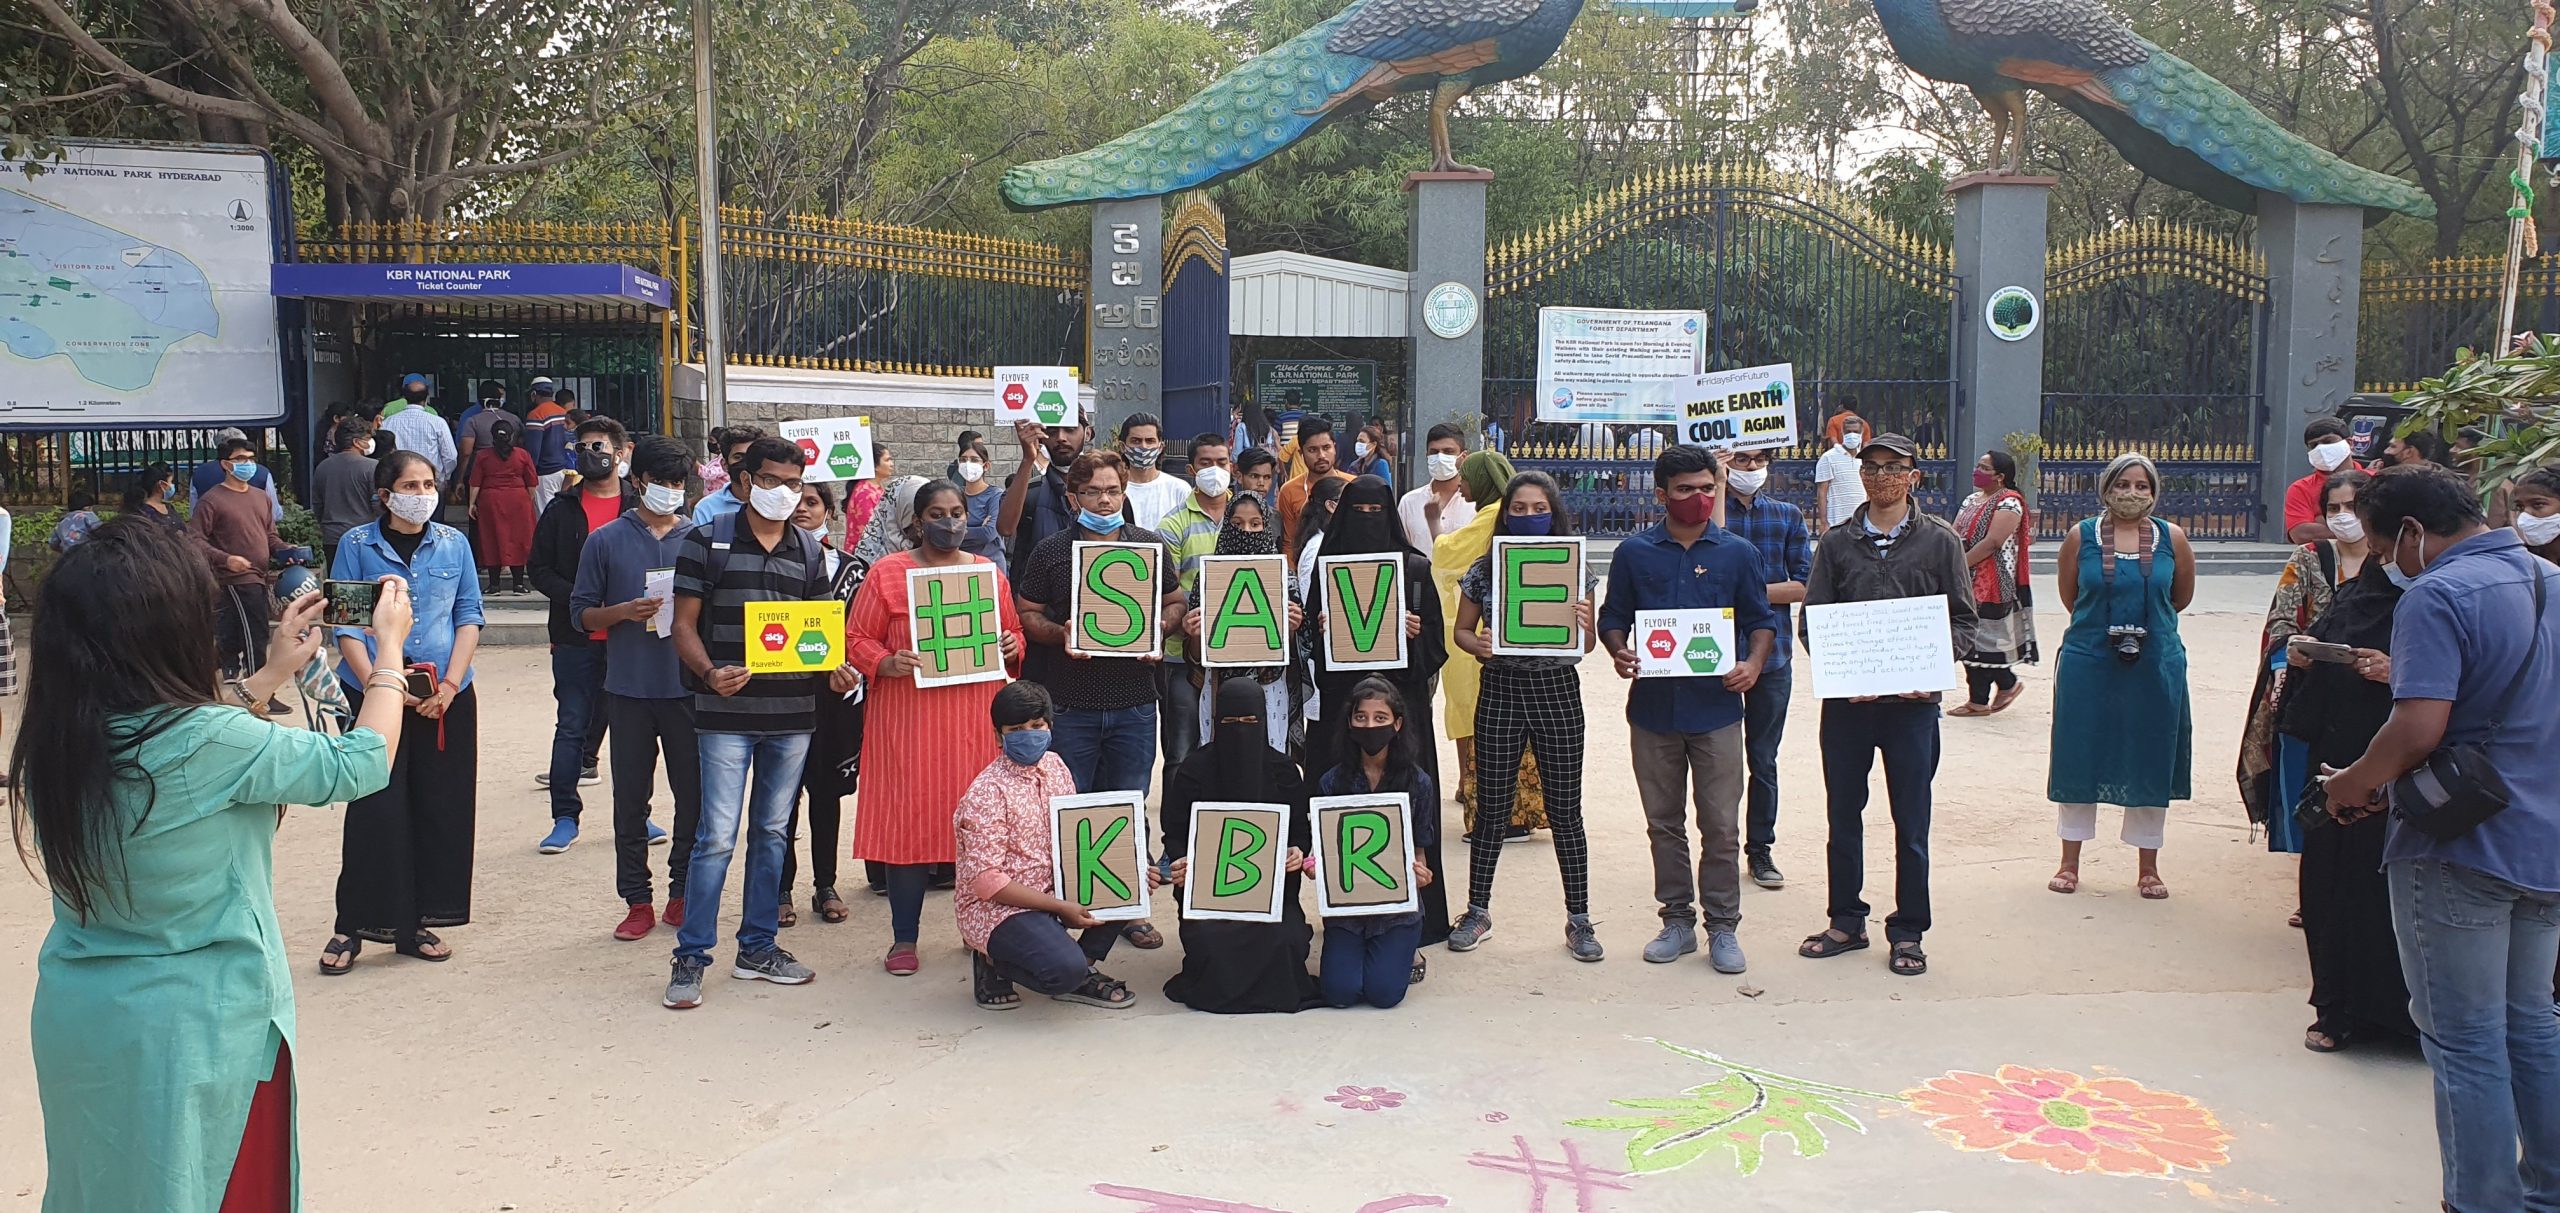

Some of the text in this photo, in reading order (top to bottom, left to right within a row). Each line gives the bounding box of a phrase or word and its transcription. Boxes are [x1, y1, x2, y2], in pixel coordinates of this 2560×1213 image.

[63, 167, 222, 182] NATIONAL PARK HYDERABAD
[230, 224, 255, 232] 1:3000
[386, 270, 512, 280] KBR NATIONAL PARK
[416, 281, 482, 290] Ticket Counter
[1301, 364, 1335, 372] Come
[1001, 374, 1030, 382] FLYOVER
[1696, 371, 1770, 386] #FridaysForFuture
[1042, 379, 1058, 389] KBR
[1687, 389, 1783, 417] MAKE EARTH
[788, 427, 820, 438] FLYOVER
[1689, 415, 1786, 443] COOL AGAIN
[834, 430, 851, 441] KBR
[1732, 436, 1790, 449] @citizensforhyd
[804, 448, 816, 459] ద్దు
[916, 547, 1570, 672] # S A V E
[758, 612, 790, 622] FLYOVER
[804, 618, 821, 628] KBR
[1644, 618, 1677, 628] FLYOVER
[1692, 623, 1711, 634] KBR
[751, 660, 784, 668] #savekbr
[1077, 810, 1398, 906] K B R
